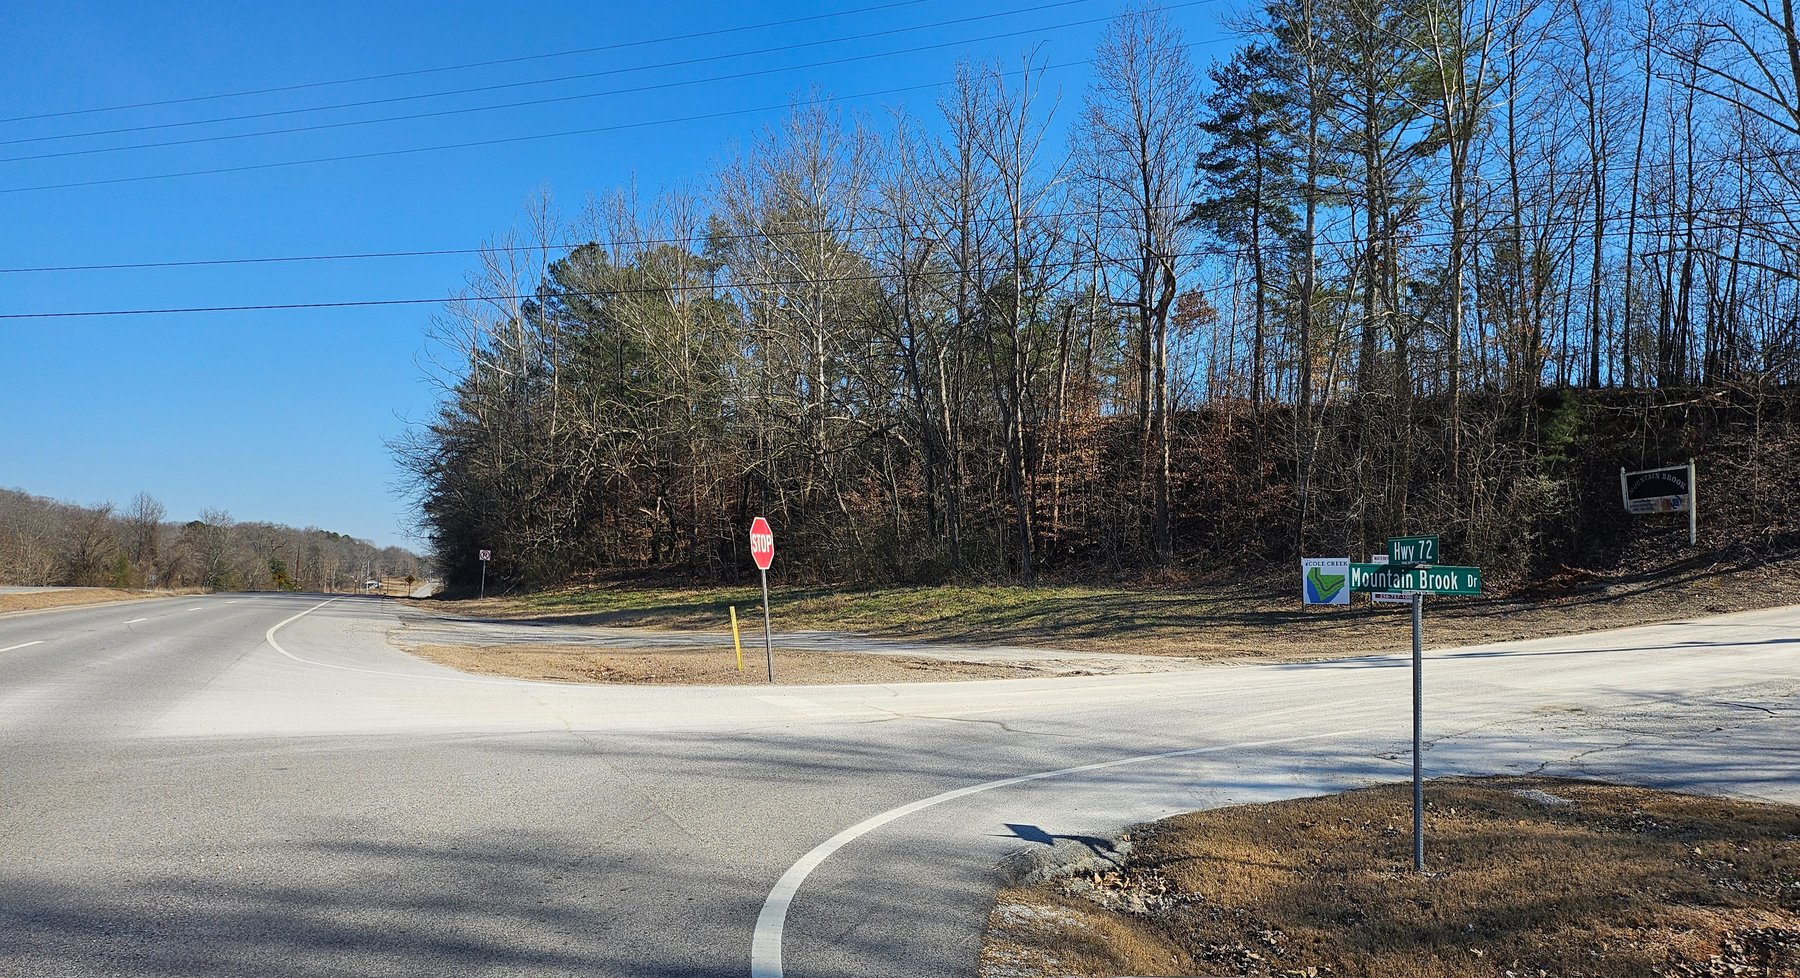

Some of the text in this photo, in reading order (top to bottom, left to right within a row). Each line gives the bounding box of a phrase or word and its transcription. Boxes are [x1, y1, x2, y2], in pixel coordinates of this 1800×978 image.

[1629, 473, 1686, 493] MOUNTAIN BROOK
[752, 533, 772, 553] STOP
[1394, 540, 1432, 561] Hwy 72
[1351, 567, 1477, 590] Mountain Brook Dr
